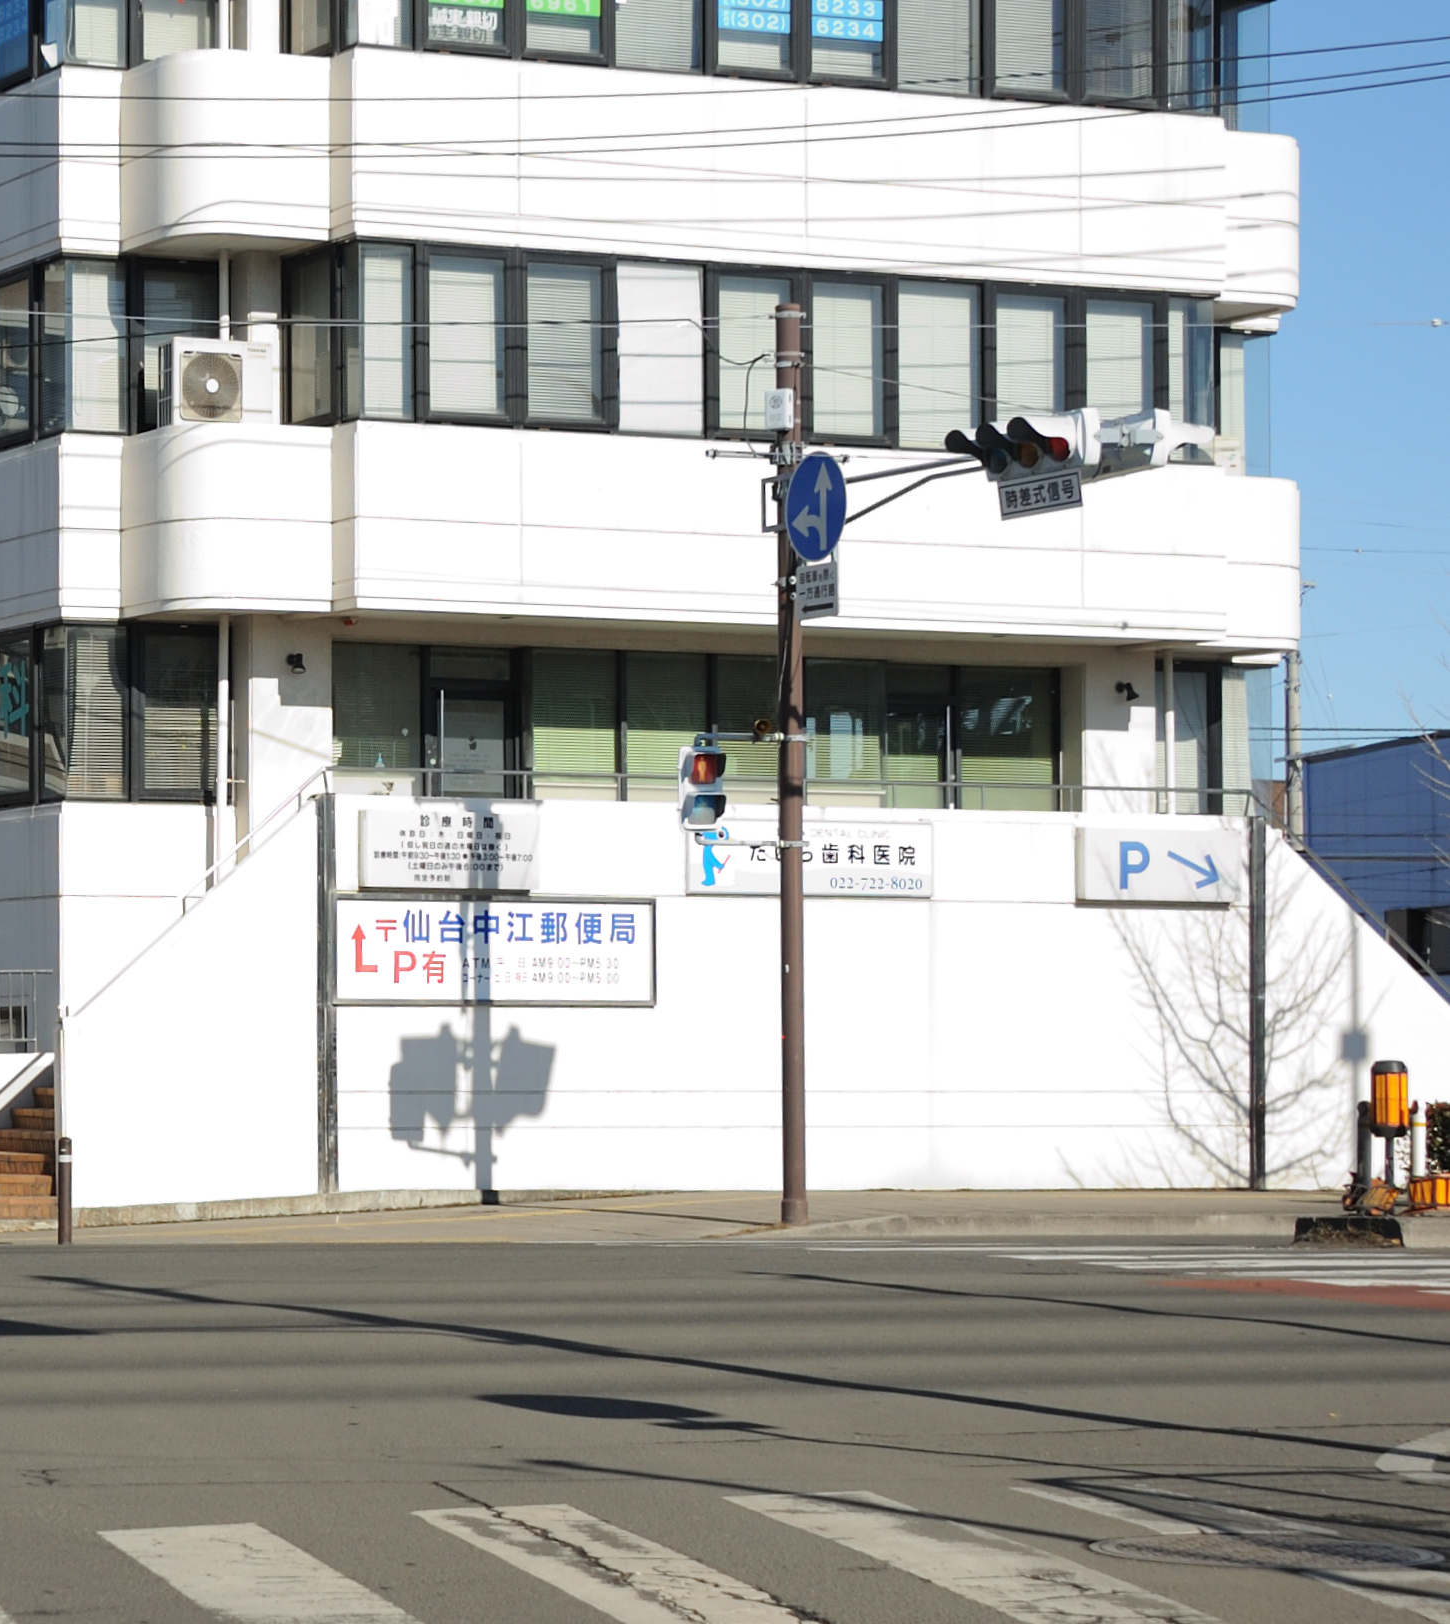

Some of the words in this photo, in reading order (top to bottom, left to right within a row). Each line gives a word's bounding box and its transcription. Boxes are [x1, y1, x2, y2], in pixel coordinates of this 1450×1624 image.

[816, 20, 876, 38] 6234
[1005, 479, 1074, 509] 時差式信号
[420, 815, 494, 829] 診療時間
[1119, 841, 1150, 890] P
[830, 877, 923, 890] 022-722-8020
[462, 957, 491, 969] ATM
